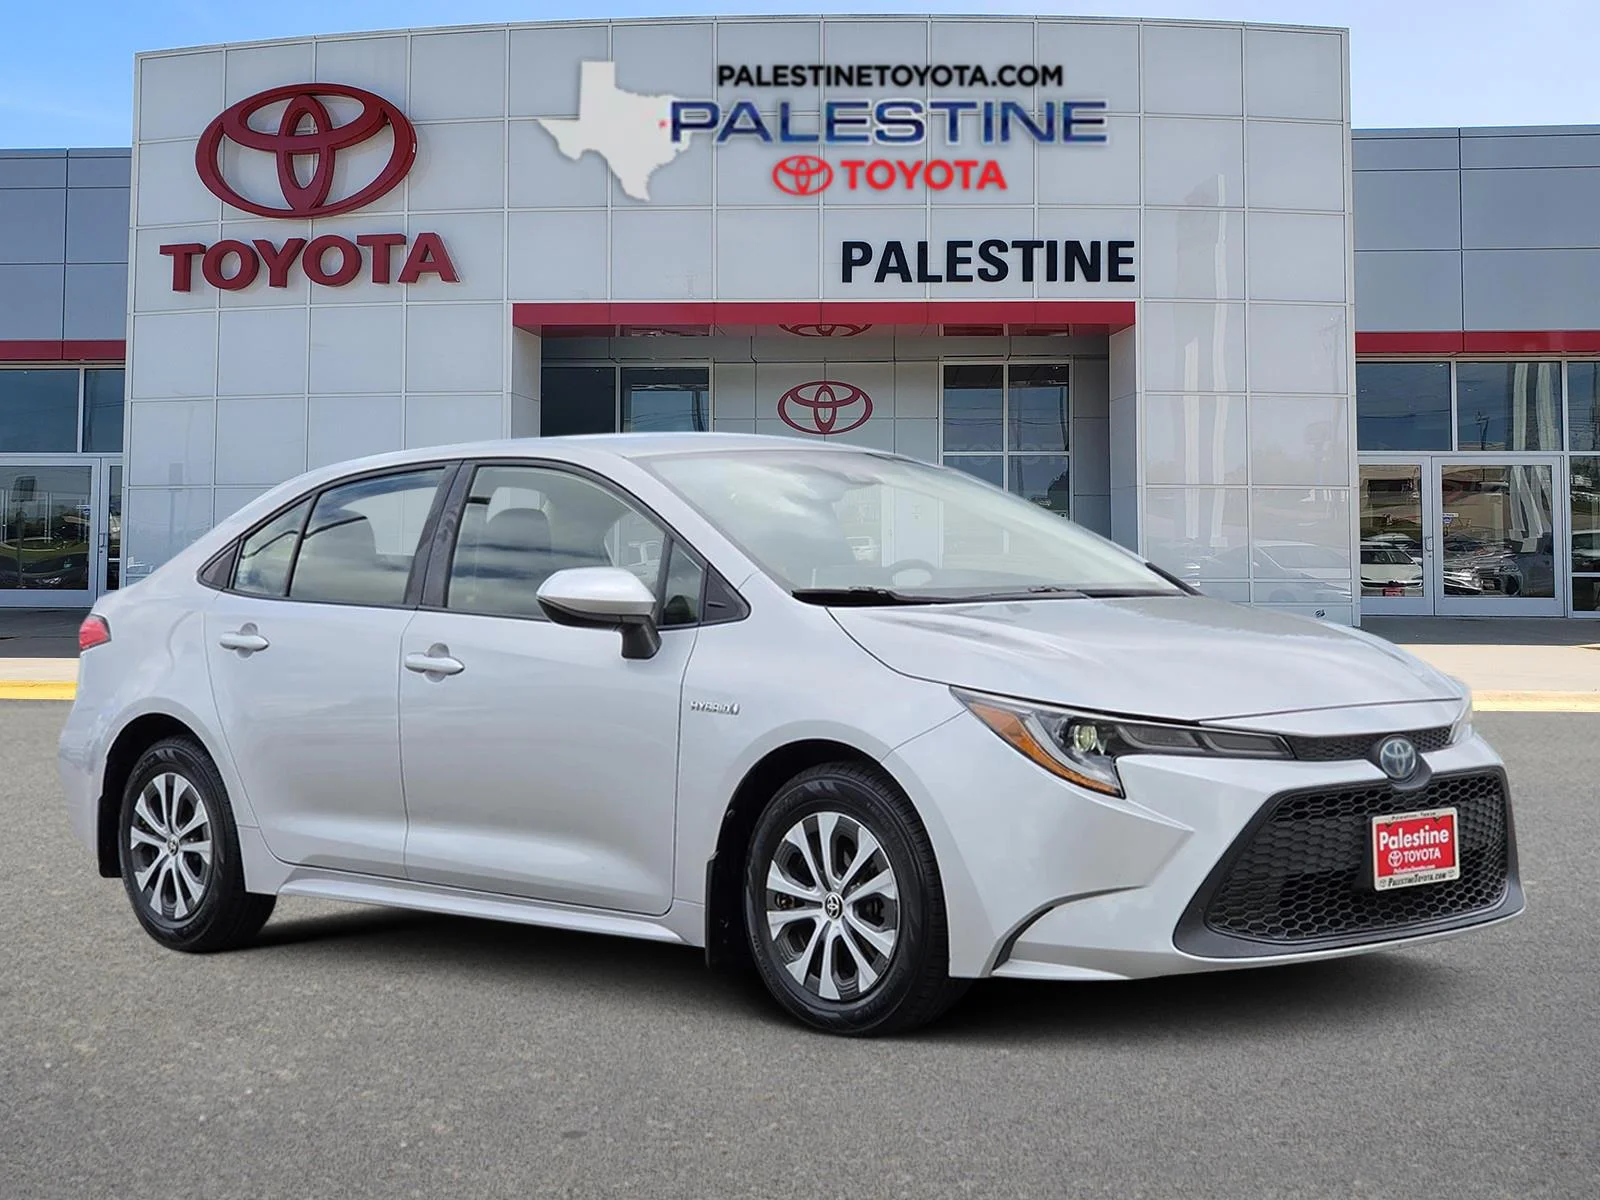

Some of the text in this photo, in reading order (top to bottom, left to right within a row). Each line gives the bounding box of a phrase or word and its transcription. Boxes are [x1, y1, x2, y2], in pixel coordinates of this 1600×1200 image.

[159, 232, 460, 292] TOYOTA
[841, 240, 1136, 284] PALESTINE
[1380, 825, 1449, 851] Palestine
[1404, 847, 1441, 863] TOYOTA
